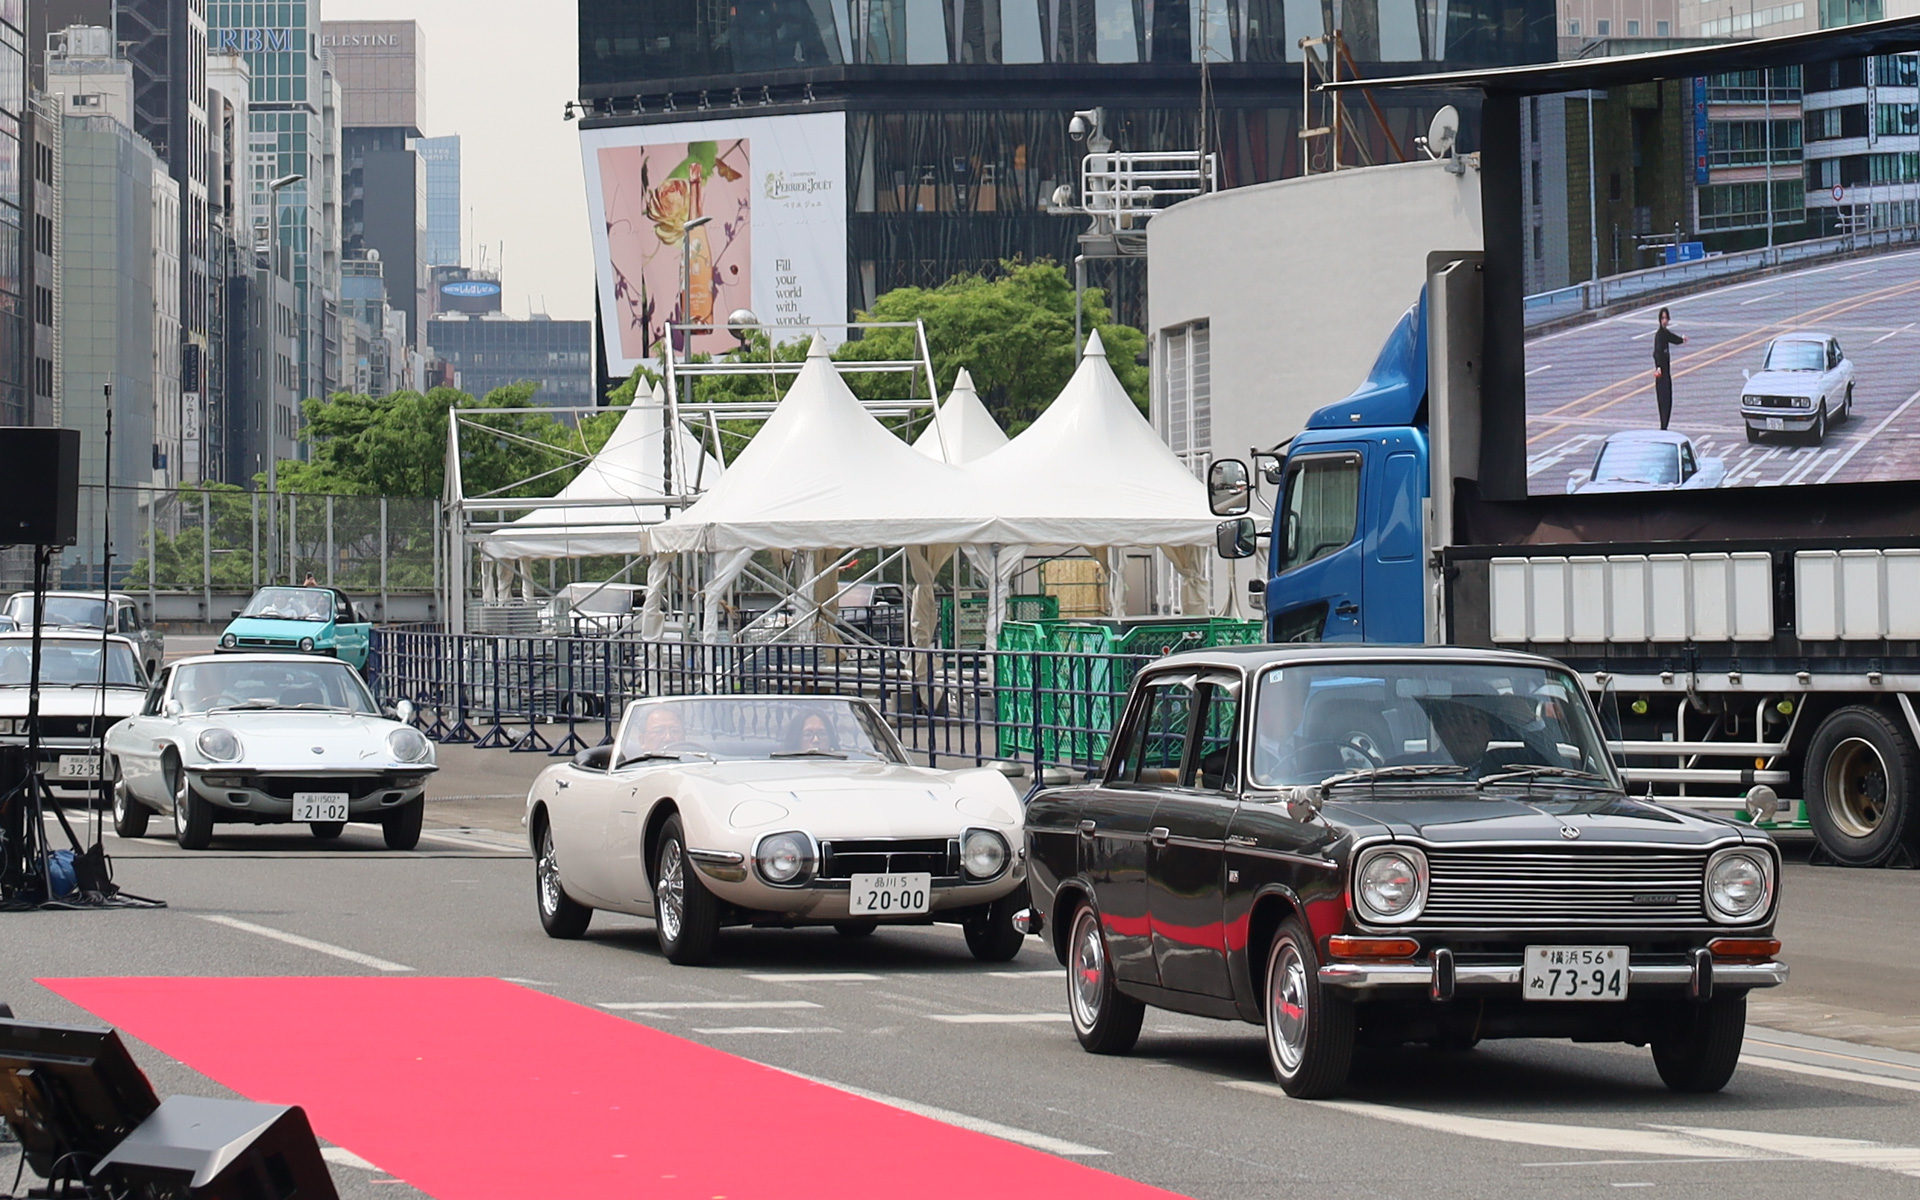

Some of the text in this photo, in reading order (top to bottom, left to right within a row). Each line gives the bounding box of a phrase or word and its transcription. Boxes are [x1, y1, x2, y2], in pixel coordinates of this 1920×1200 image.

[219, 28, 292, 52] RBM
[322, 34, 399, 47] ELESTINE
[775, 259, 791, 271] Fill
[775, 276, 797, 288] your
[775, 286, 802, 299] world
[775, 300, 797, 312] with
[775, 313, 811, 325] wonder
[305, 804, 345, 819] 21-02
[867, 890, 924, 910] 20-00
[1530, 969, 1621, 996] ぬ 73-94
